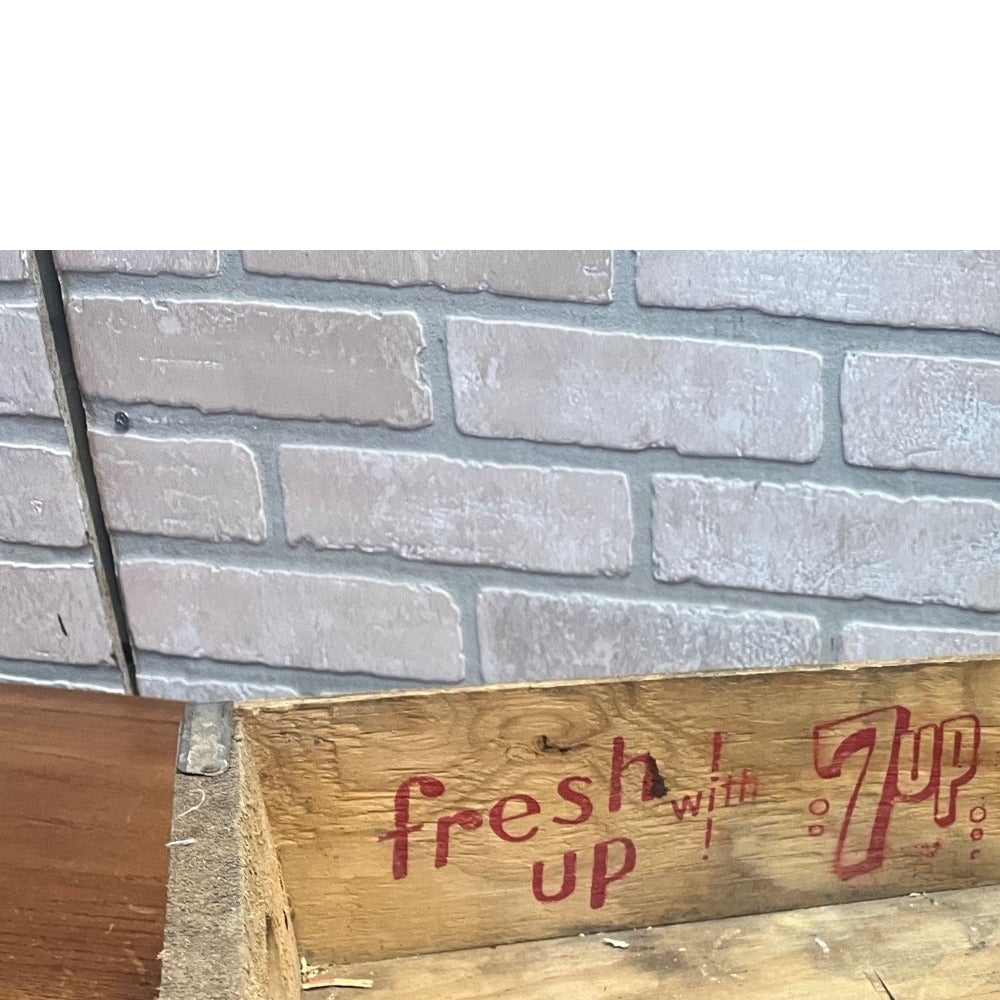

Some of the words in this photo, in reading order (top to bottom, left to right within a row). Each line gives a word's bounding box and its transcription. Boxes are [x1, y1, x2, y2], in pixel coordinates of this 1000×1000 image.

[378, 735, 660, 880] fresh
[670, 768, 761, 821] with
[531, 836, 637, 909] up
